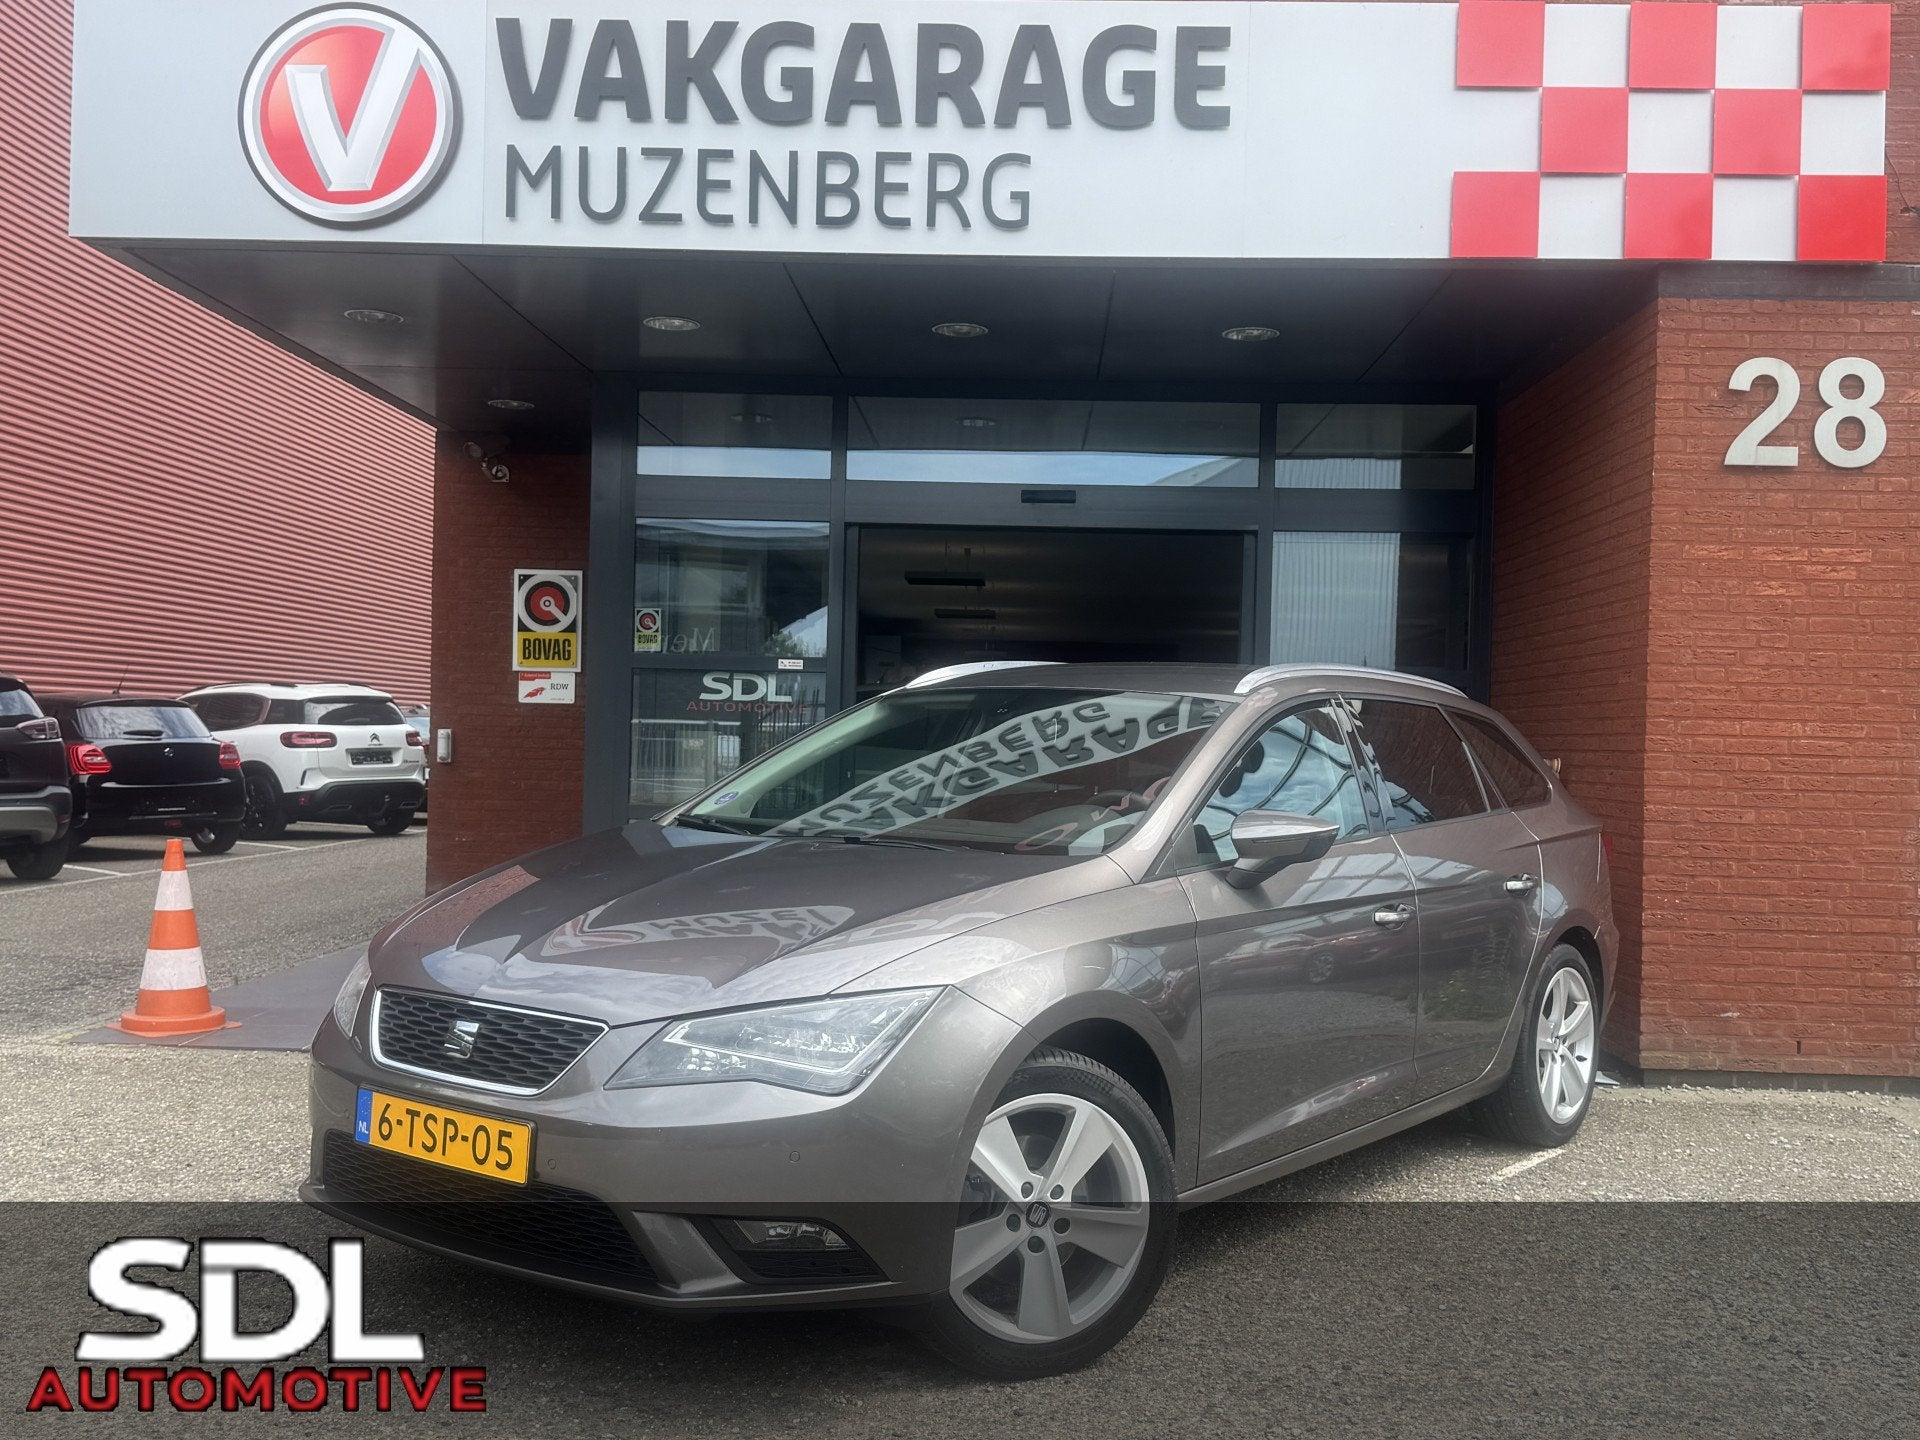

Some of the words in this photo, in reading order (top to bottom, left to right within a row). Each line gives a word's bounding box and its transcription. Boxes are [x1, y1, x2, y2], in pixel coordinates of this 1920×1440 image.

[494, 16, 1231, 130] VAKGARAGE
[505, 143, 1032, 230] MUZENBERG
[1724, 356, 1887, 468] 28
[522, 637, 572, 662] BOVAG
[637, 633, 658, 645] BOVAG
[550, 683, 569, 691] RDW
[699, 671, 792, 702] SDL
[686, 701, 806, 714] AUTOMOTIVE
[358, 1120, 369, 1134] NL
[378, 1102, 513, 1171] 6-TSP-05
